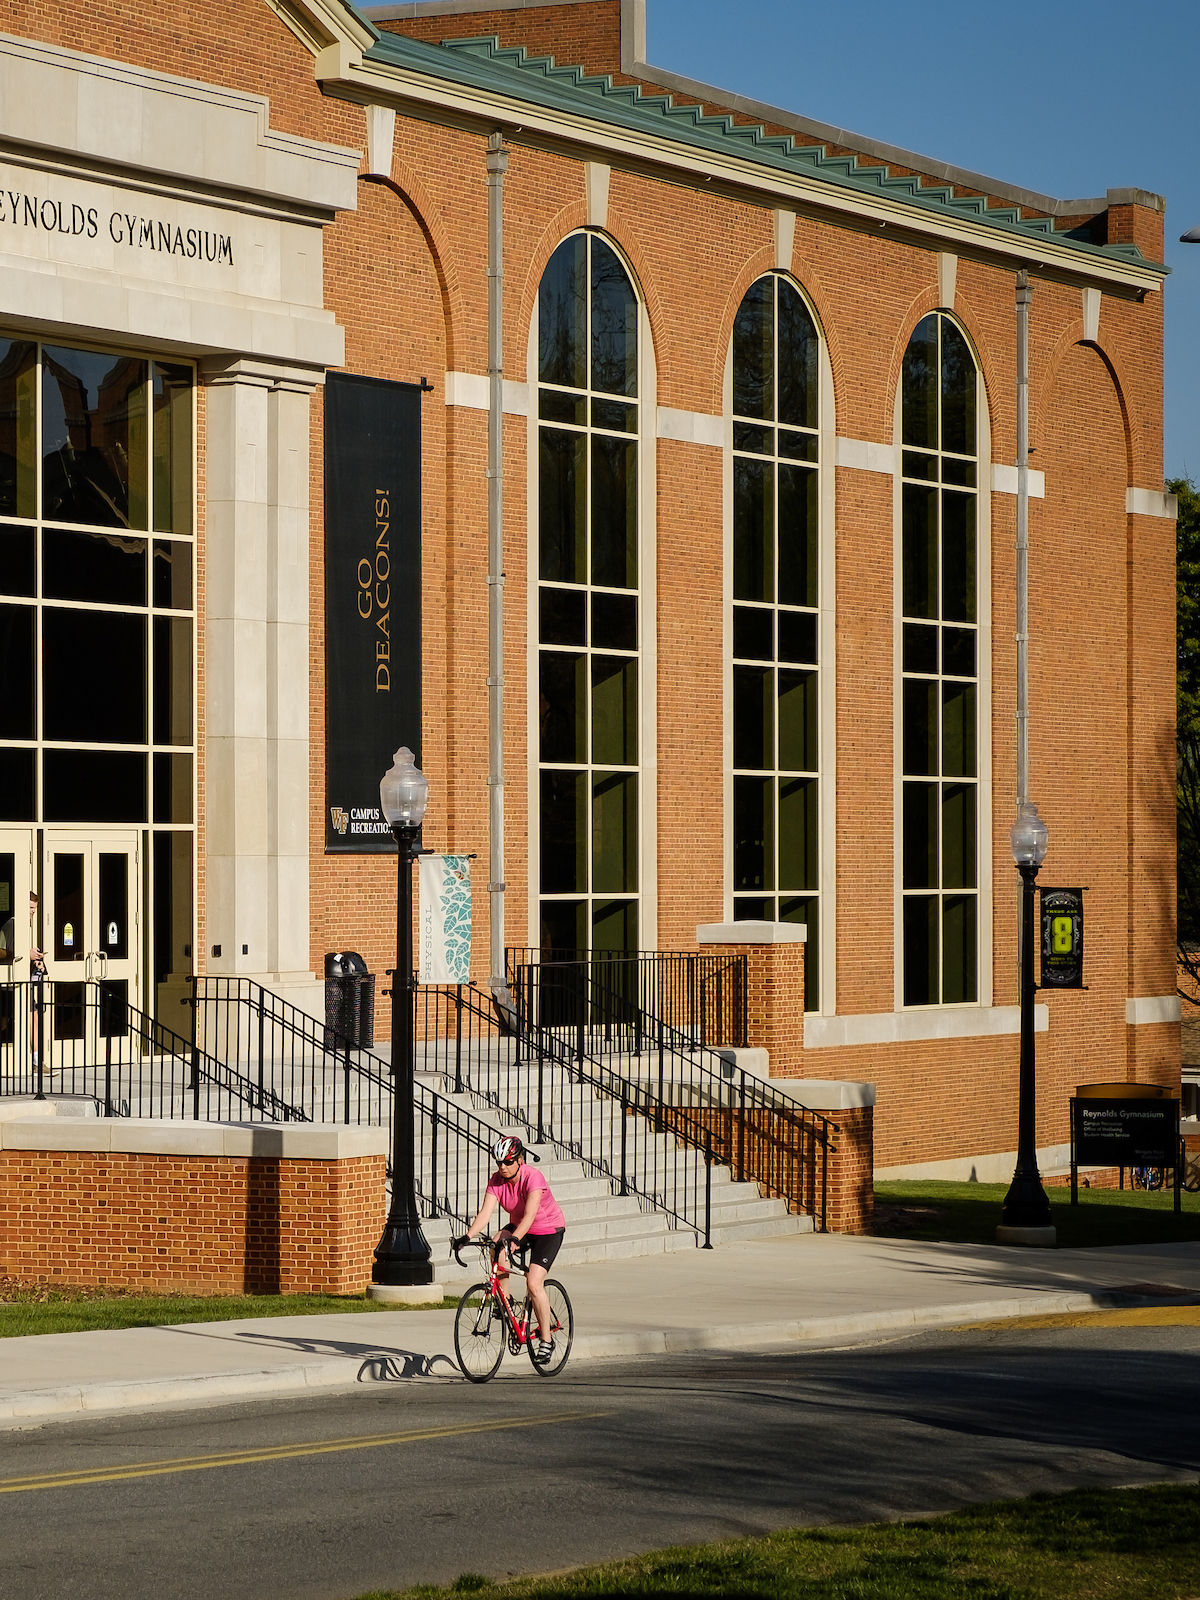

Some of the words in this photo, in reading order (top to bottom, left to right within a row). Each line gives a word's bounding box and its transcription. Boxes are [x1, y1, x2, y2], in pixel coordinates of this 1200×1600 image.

[109, 211, 235, 266] GYMNASIUM
[357, 557, 373, 619] GO
[375, 488, 391, 693] DEACONS!
[350, 807, 380, 820] CAMPUS
[350, 821, 393, 834] RECREATIO
[424, 904, 433, 981] PHYSICAL
[1051, 916, 1073, 954] 8
[1082, 1109, 1118, 1119] Reynolds
[1119, 1109, 1164, 1119] Gymnasium
